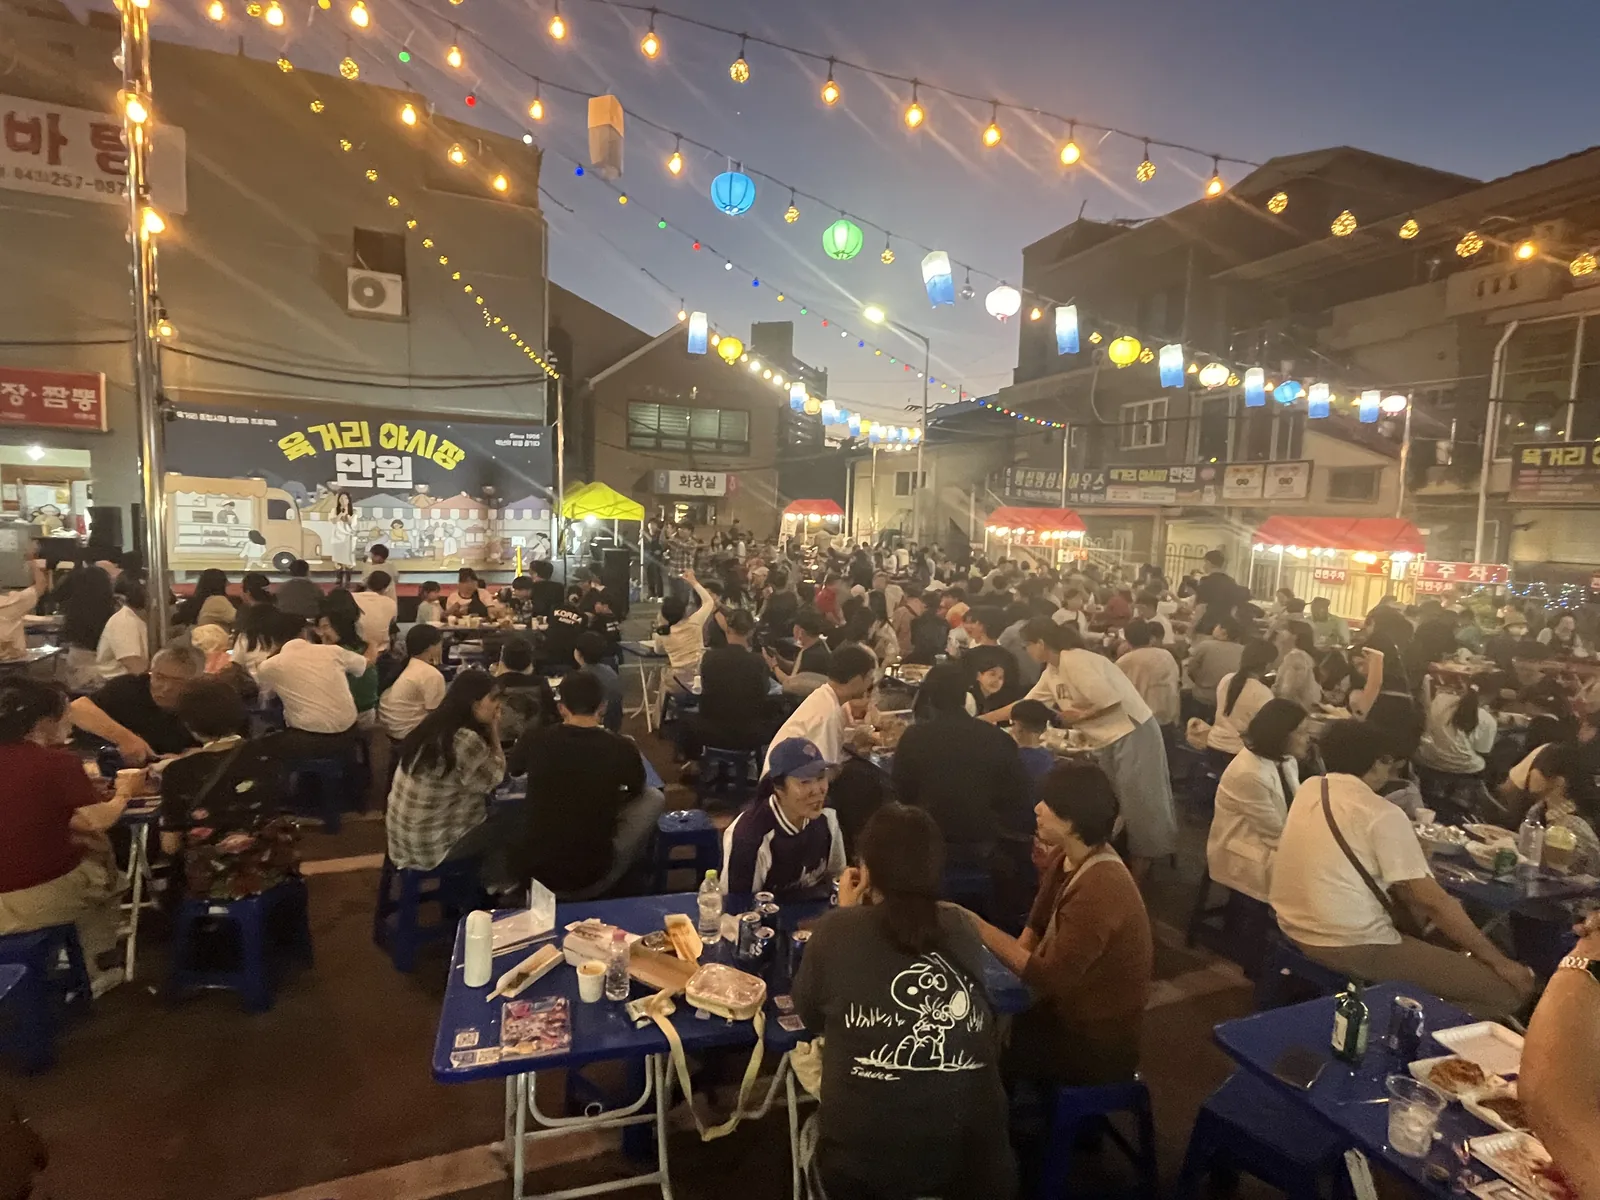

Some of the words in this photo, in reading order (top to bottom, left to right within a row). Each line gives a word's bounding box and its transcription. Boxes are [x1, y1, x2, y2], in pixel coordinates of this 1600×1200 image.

[278, 421, 372, 461] 육거리
[379, 422, 466, 471] 야시장
[1521, 446, 1587, 466] 육거리
[336, 453, 413, 489] 만원
[679, 473, 717, 489] 화장실
[553, 609, 583, 625] KOREA
